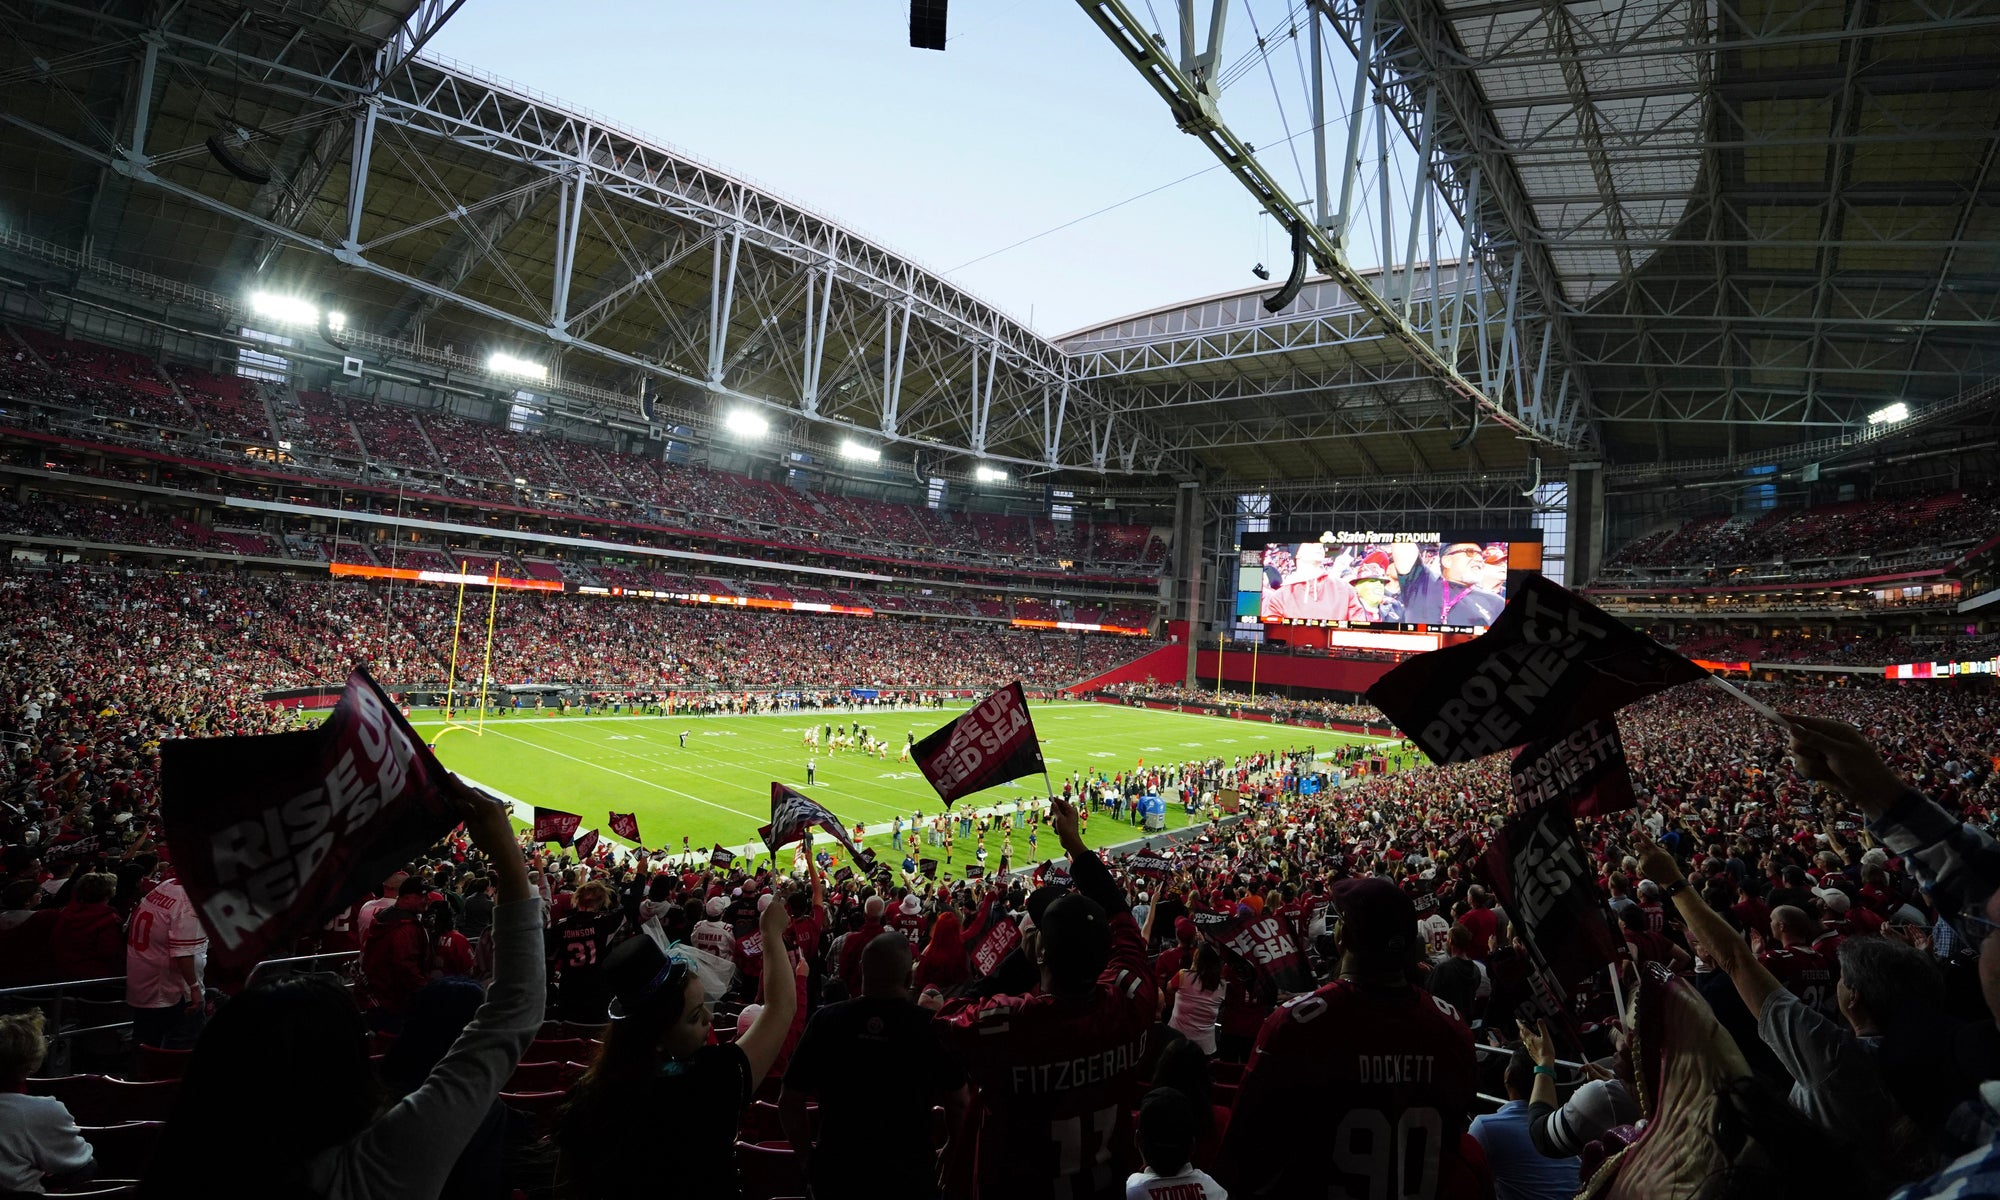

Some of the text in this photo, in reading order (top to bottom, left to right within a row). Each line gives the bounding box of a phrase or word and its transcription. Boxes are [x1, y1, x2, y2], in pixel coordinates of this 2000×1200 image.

[1395, 532, 1440, 543] STADIUM
[930, 690, 1012, 776] RISE UP
[1512, 718, 1599, 794] PROTECT
[211, 685, 387, 885] RISE UP
[933, 746, 983, 797] RED
[1516, 733, 1619, 814] THE NEST!
[561, 817, 578, 826] UP
[614, 817, 628, 831] UP
[202, 831, 335, 950] RED
[562, 927, 596, 939] JOHNSON
[741, 931, 763, 949] RIS
[992, 921, 1007, 939] UP
[1251, 918, 1279, 939] UP
[567, 939, 597, 967] 31
[979, 952, 997, 976] RED
[1253, 934, 1298, 964] SEA!
[1012, 1029, 1147, 1095] FITZGERALD
[1359, 1054, 1435, 1084] DOCKETT
[1328, 1106, 1443, 1200] 90
